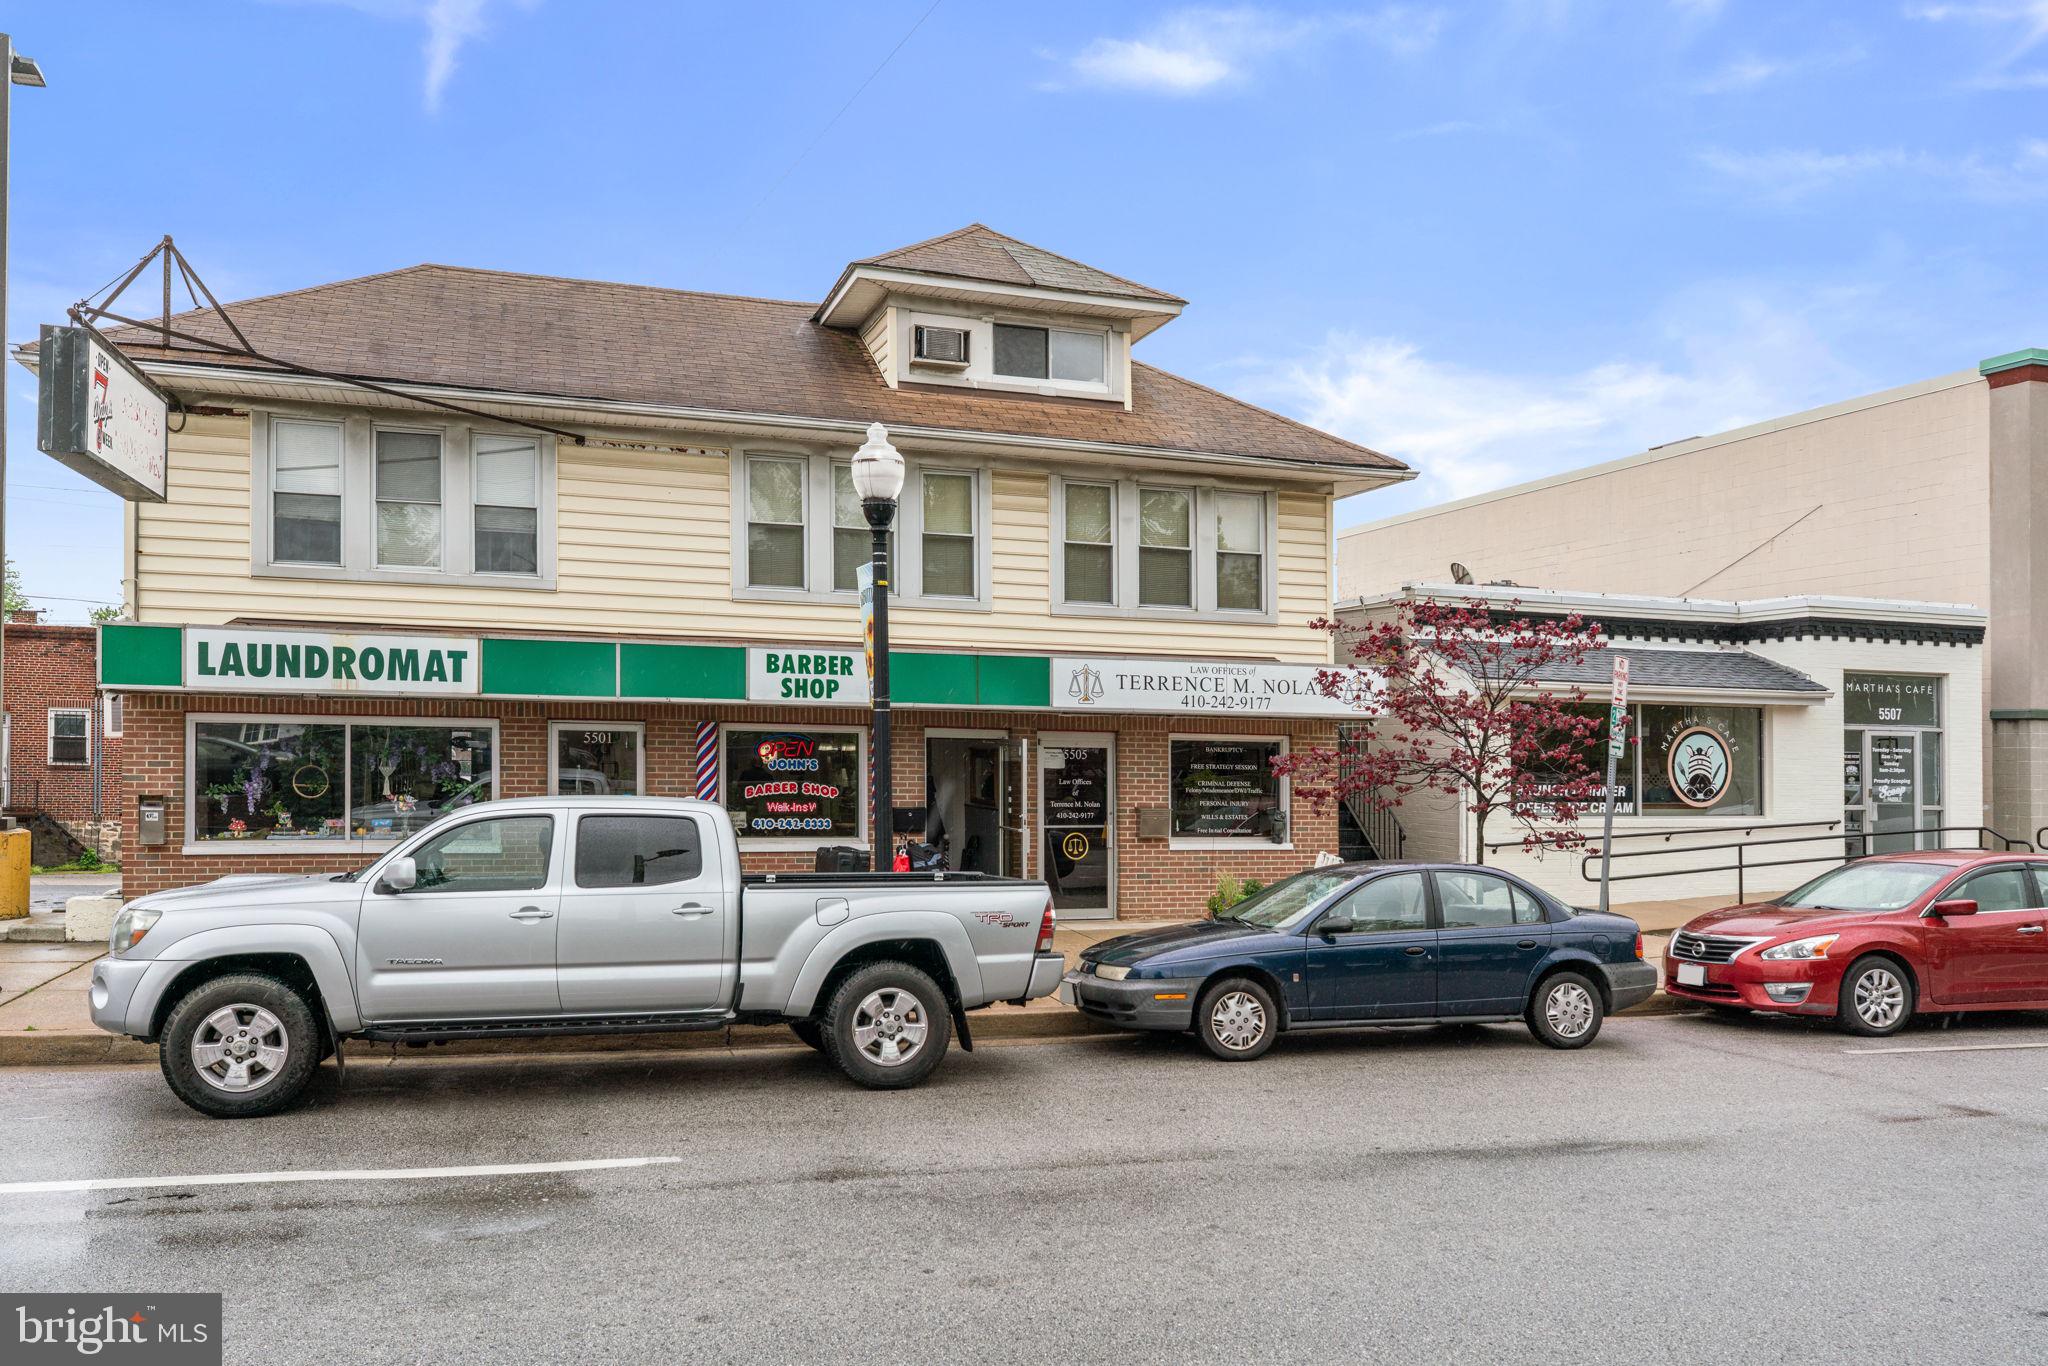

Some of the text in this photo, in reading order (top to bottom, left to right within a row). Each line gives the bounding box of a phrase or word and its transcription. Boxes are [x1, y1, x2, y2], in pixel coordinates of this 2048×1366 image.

[97, 351, 109, 374] OPEN
[93, 366, 109, 452] 7
[198, 641, 468, 683] LAUNDROMAT
[766, 653, 854, 676] BARBER
[1190, 666, 1257, 678] LAW OFFICES of
[781, 677, 840, 699] SHOP
[1116, 674, 1225, 693] TERRENCE
[1233, 678, 1255, 694] M.
[1846, 683, 1901, 694] MARTHA'S
[1181, 695, 1271, 710] 410-242-9177
[1878, 707, 1902, 720] 5507
[583, 732, 612, 744] 5501
[758, 741, 815, 757] OPEN
[1064, 749, 1088, 760] 5505
[768, 758, 819, 771] JOHN'S
[745, 782, 839, 799] BARBER SHOP
[1072, 789, 1080, 797] of
[1878, 785, 1906, 799] Scoop
[1084, 800, 1100, 808] Nolan
[1590, 802, 1634, 814] CRAM
[752, 818, 831, 829] 410-242-8333
[974, 912, 1014, 925] TRD
[385, 958, 444, 966] TACOMA
